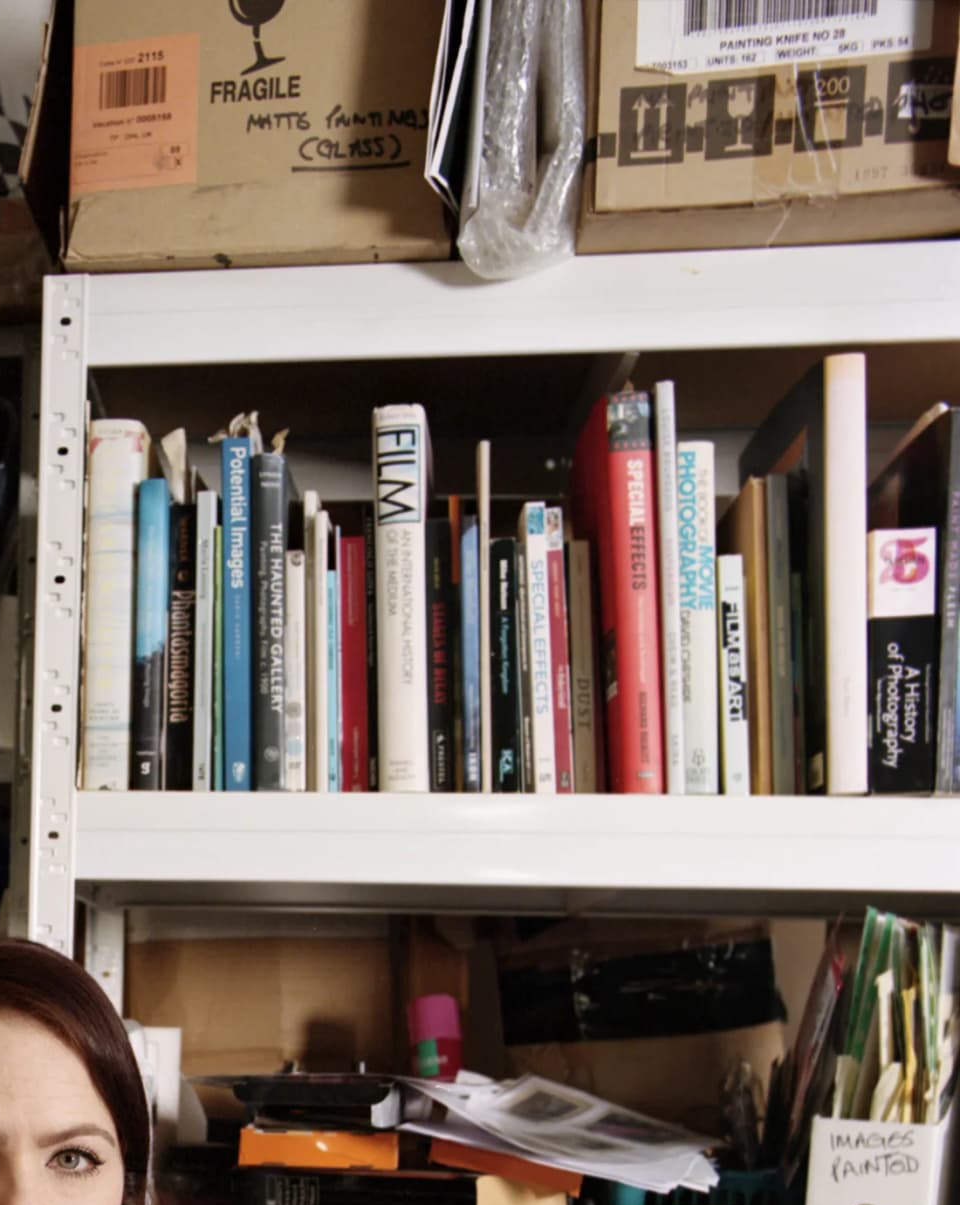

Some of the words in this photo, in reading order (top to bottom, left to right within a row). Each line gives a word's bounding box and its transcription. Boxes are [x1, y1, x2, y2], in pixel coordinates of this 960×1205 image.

[137, 50, 165, 63] 2115
[719, 35, 773, 51] PAINTING
[775, 31, 809, 45] KNIFE
[812, 30, 830, 41] NO
[776, 46, 817, 59] WEIGHT
[210, 75, 301, 104] FRAGILE
[816, 76, 850, 97] 200
[229, 445, 247, 523] Potential
[378, 427, 416, 524] FILM
[626, 458, 645, 527] SPECIAL
[698, 470, 708, 488] THE
[678, 451, 697, 610] PHOTOGRAPHY
[698, 492, 709, 525] BOOK
[228, 525, 247, 590] Images
[269, 522, 284, 556] THE
[387, 529, 398, 545] OF
[387, 549, 398, 568] THE
[401, 528, 413, 546] AN
[630, 526, 648, 591] EFFECTS
[269, 558, 284, 639] HAUNTED
[386, 569, 398, 617] MEDIUM
[401, 548, 413, 637] INTERNATIONAL
[530, 559, 546, 634] SPECIAL
[698, 545, 714, 610] MOVIE
[723, 601, 739, 649] FILM
[946, 586, 956, 630] FLESH
[169, 589, 195, 724] Phantasmagoria
[400, 638, 413, 686] HISTORY
[886, 642, 902, 662] of
[903, 666, 921, 680] A
[270, 643, 284, 714] GALLERY
[533, 638, 549, 716] EFFECTS
[726, 680, 744, 722] ART
[575, 677, 592, 731] DUST
[881, 664, 903, 769] Photography
[900, 683, 921, 744] History
[829, 1131, 916, 1151] IMAGES
[831, 1156, 920, 1183] PAINTED
